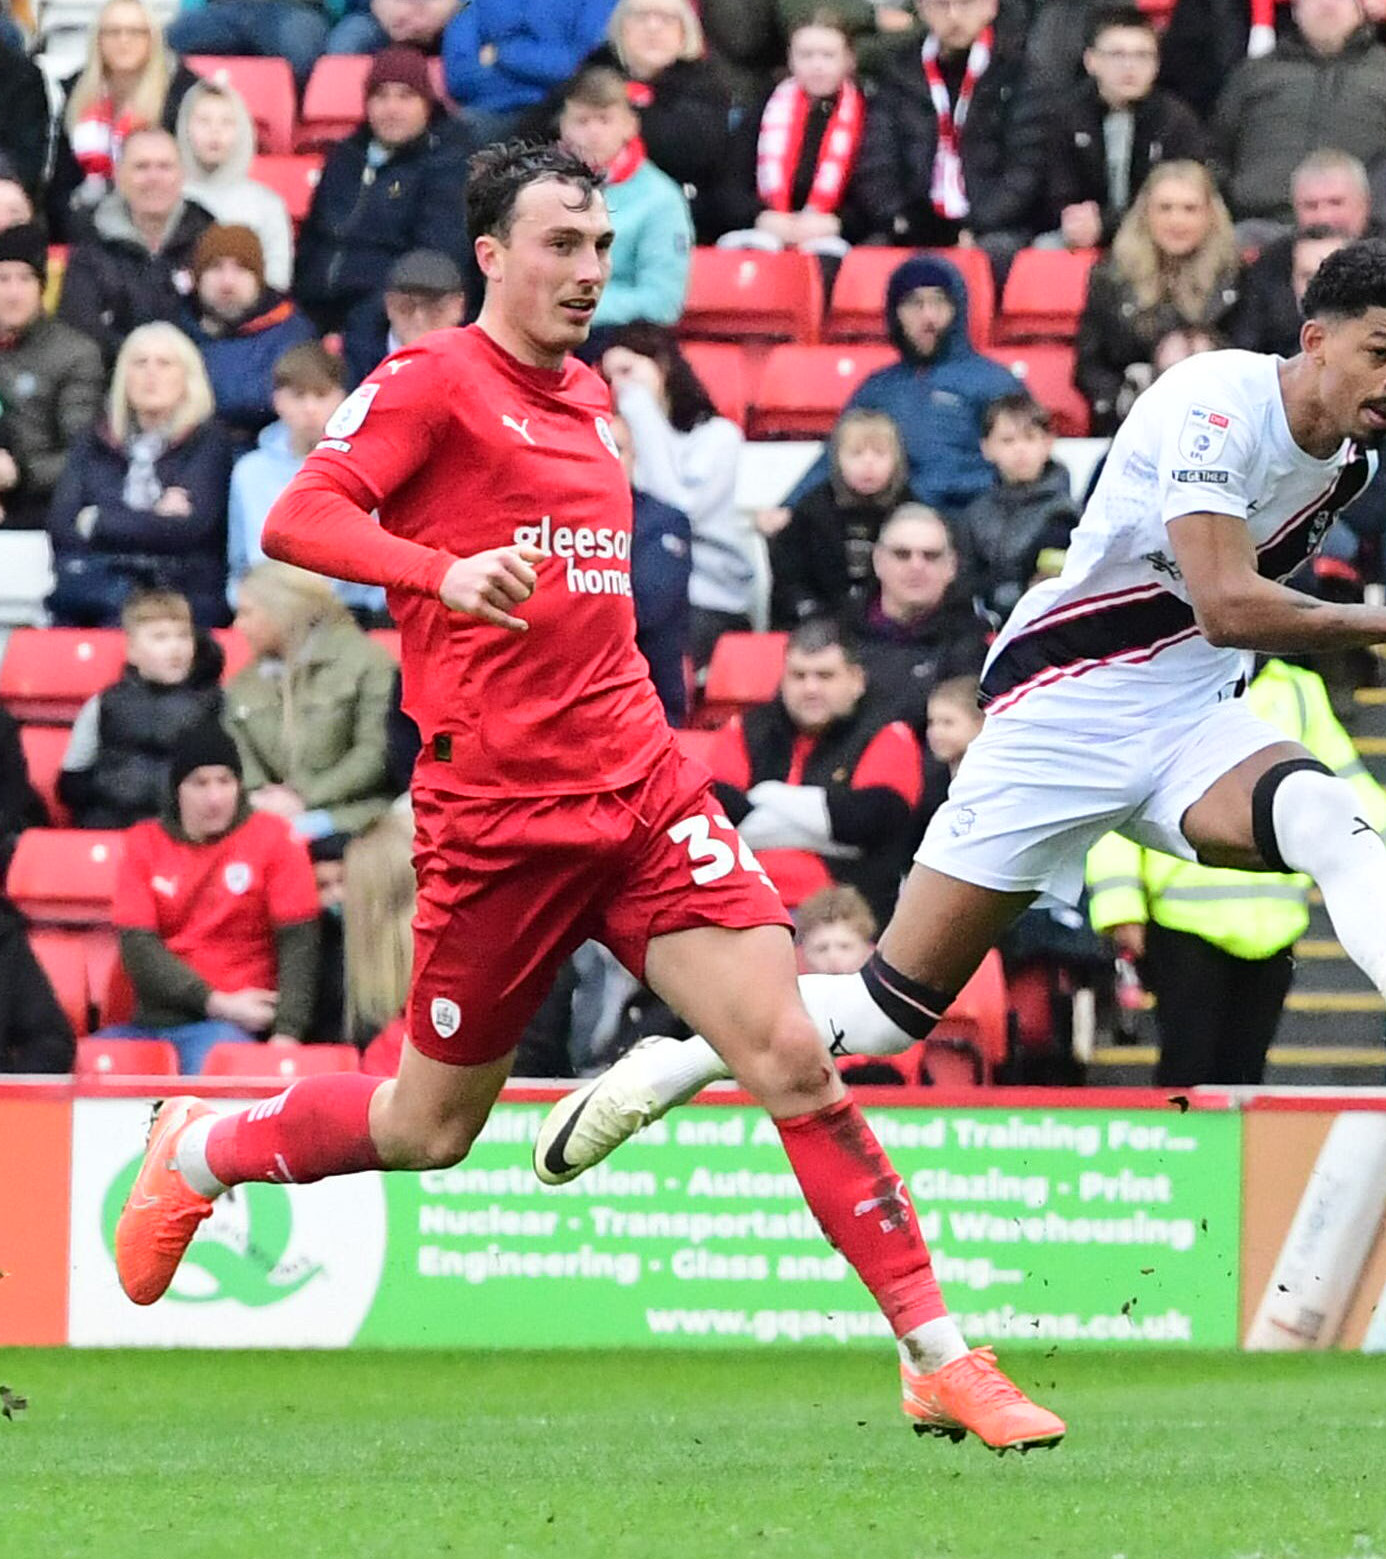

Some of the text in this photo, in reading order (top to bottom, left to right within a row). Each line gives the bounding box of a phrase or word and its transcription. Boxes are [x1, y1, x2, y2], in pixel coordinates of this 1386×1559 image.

[513, 514, 632, 561] gleeso
[676, 1115, 745, 1146] and
[951, 1115, 1100, 1157] Training
[418, 1165, 657, 1197] Constrction
[910, 1168, 1049, 1209] Glazing
[1079, 1168, 1172, 1203] Print
[418, 1205, 559, 1236] Nuclear
[589, 1206, 824, 1244] Transportati
[948, 1209, 1196, 1251] Warehousing
[418, 1244, 641, 1286] Engineering
[671, 1247, 769, 1281] Glass
[776, 1250, 850, 1282] and
